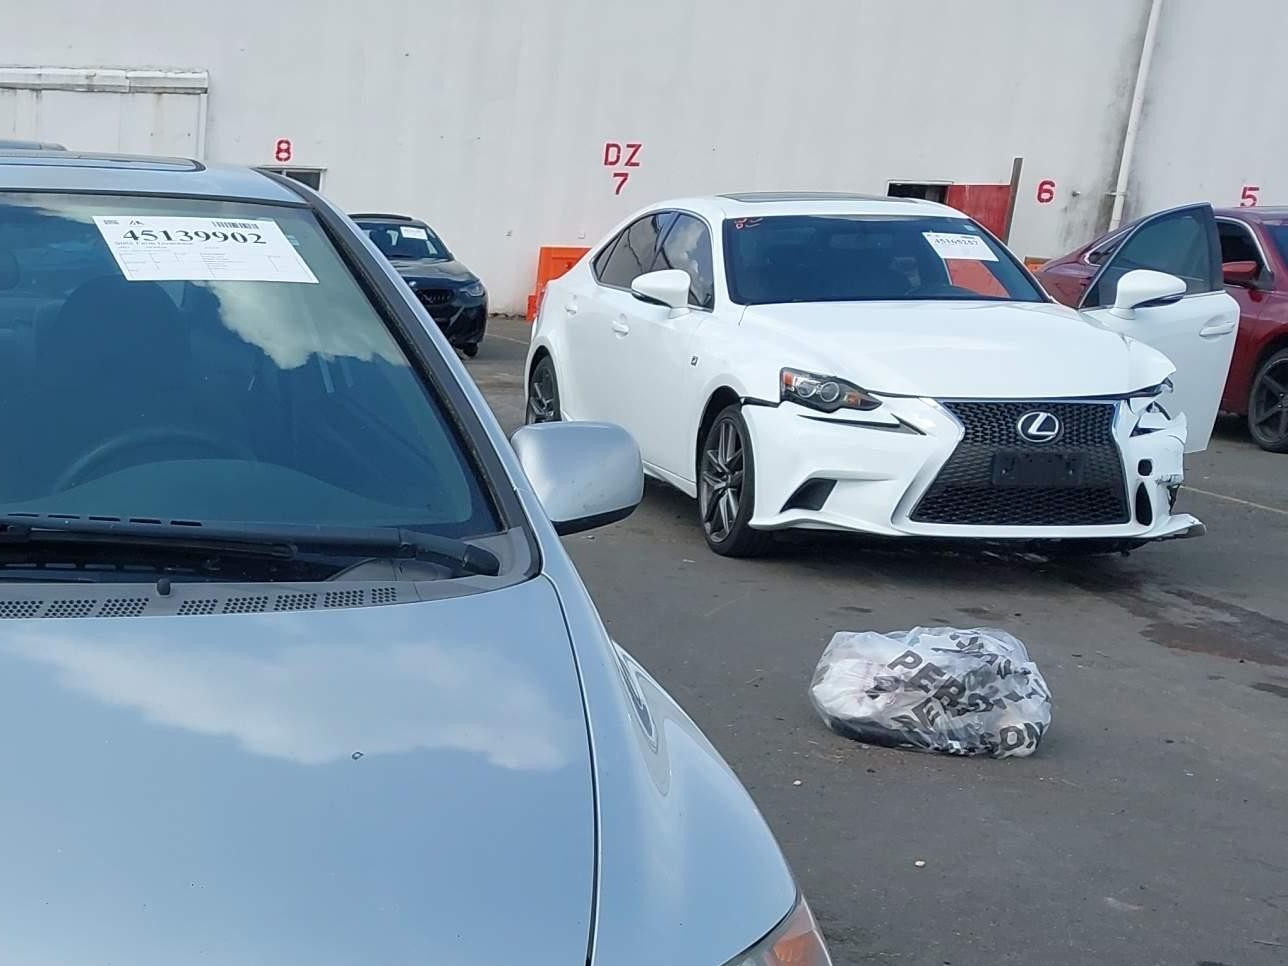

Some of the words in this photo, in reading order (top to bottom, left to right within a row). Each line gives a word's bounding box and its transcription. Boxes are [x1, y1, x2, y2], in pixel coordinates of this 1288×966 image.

[275, 139, 291, 162] 8
[604, 143, 642, 167] DZ
[612, 172, 629, 195] 7
[1037, 180, 1056, 203] 6
[1240, 186, 1260, 207] 5
[122, 228, 268, 245] 45139902
